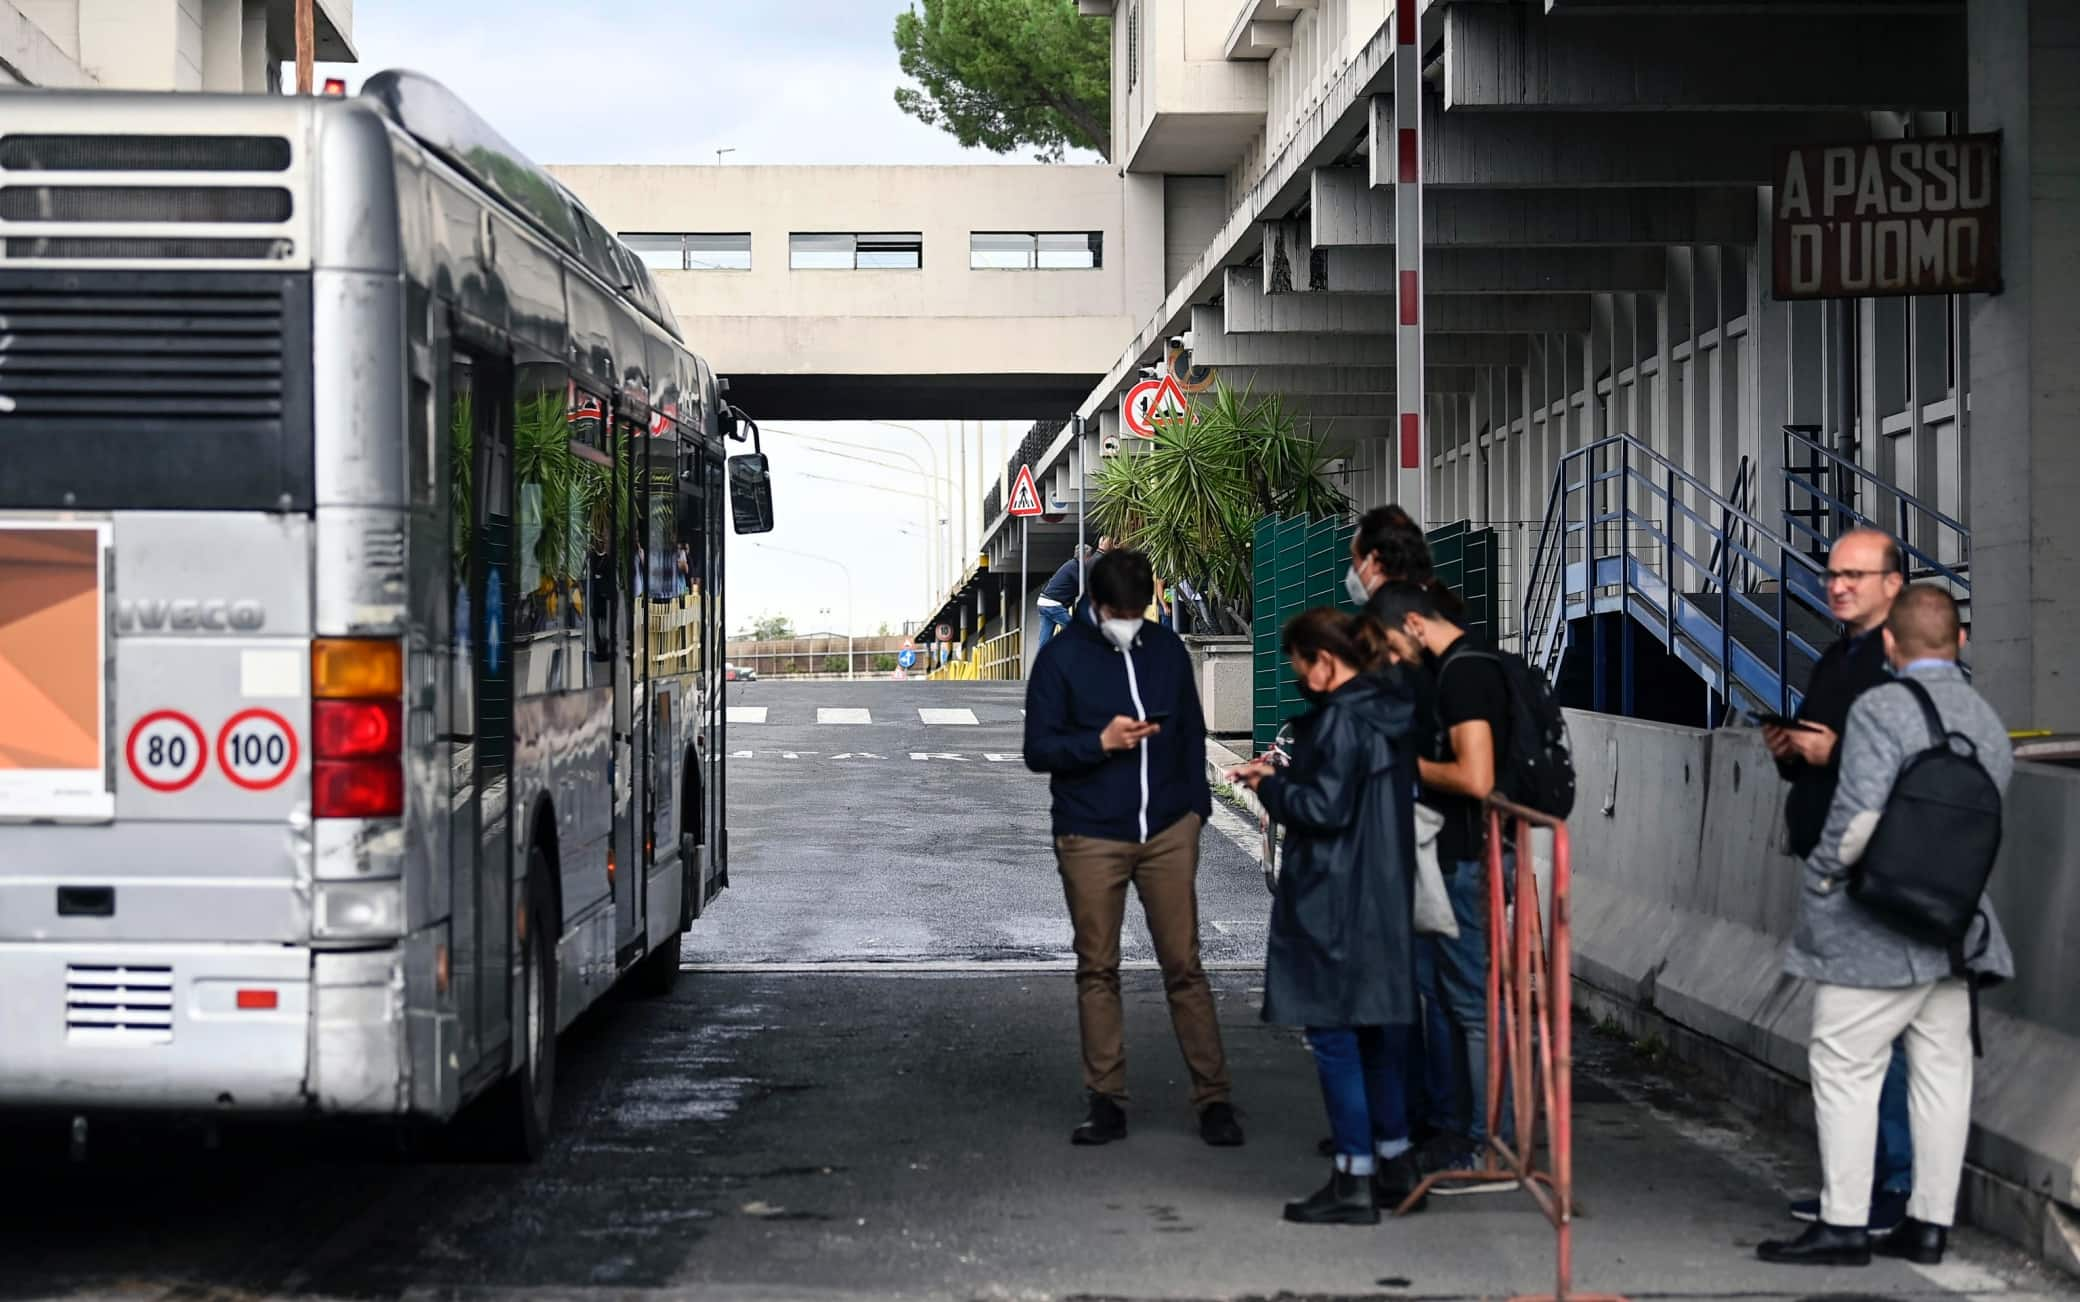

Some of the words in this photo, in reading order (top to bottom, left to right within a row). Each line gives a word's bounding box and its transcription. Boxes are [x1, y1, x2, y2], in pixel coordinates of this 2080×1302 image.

[1780, 150, 1812, 219] A
[1823, 143, 1992, 217] PASSO
[1791, 217, 1979, 293] D'UOMO
[117, 599, 265, 631] IVECO
[148, 735, 186, 767] 80
[231, 733, 284, 766] 100
